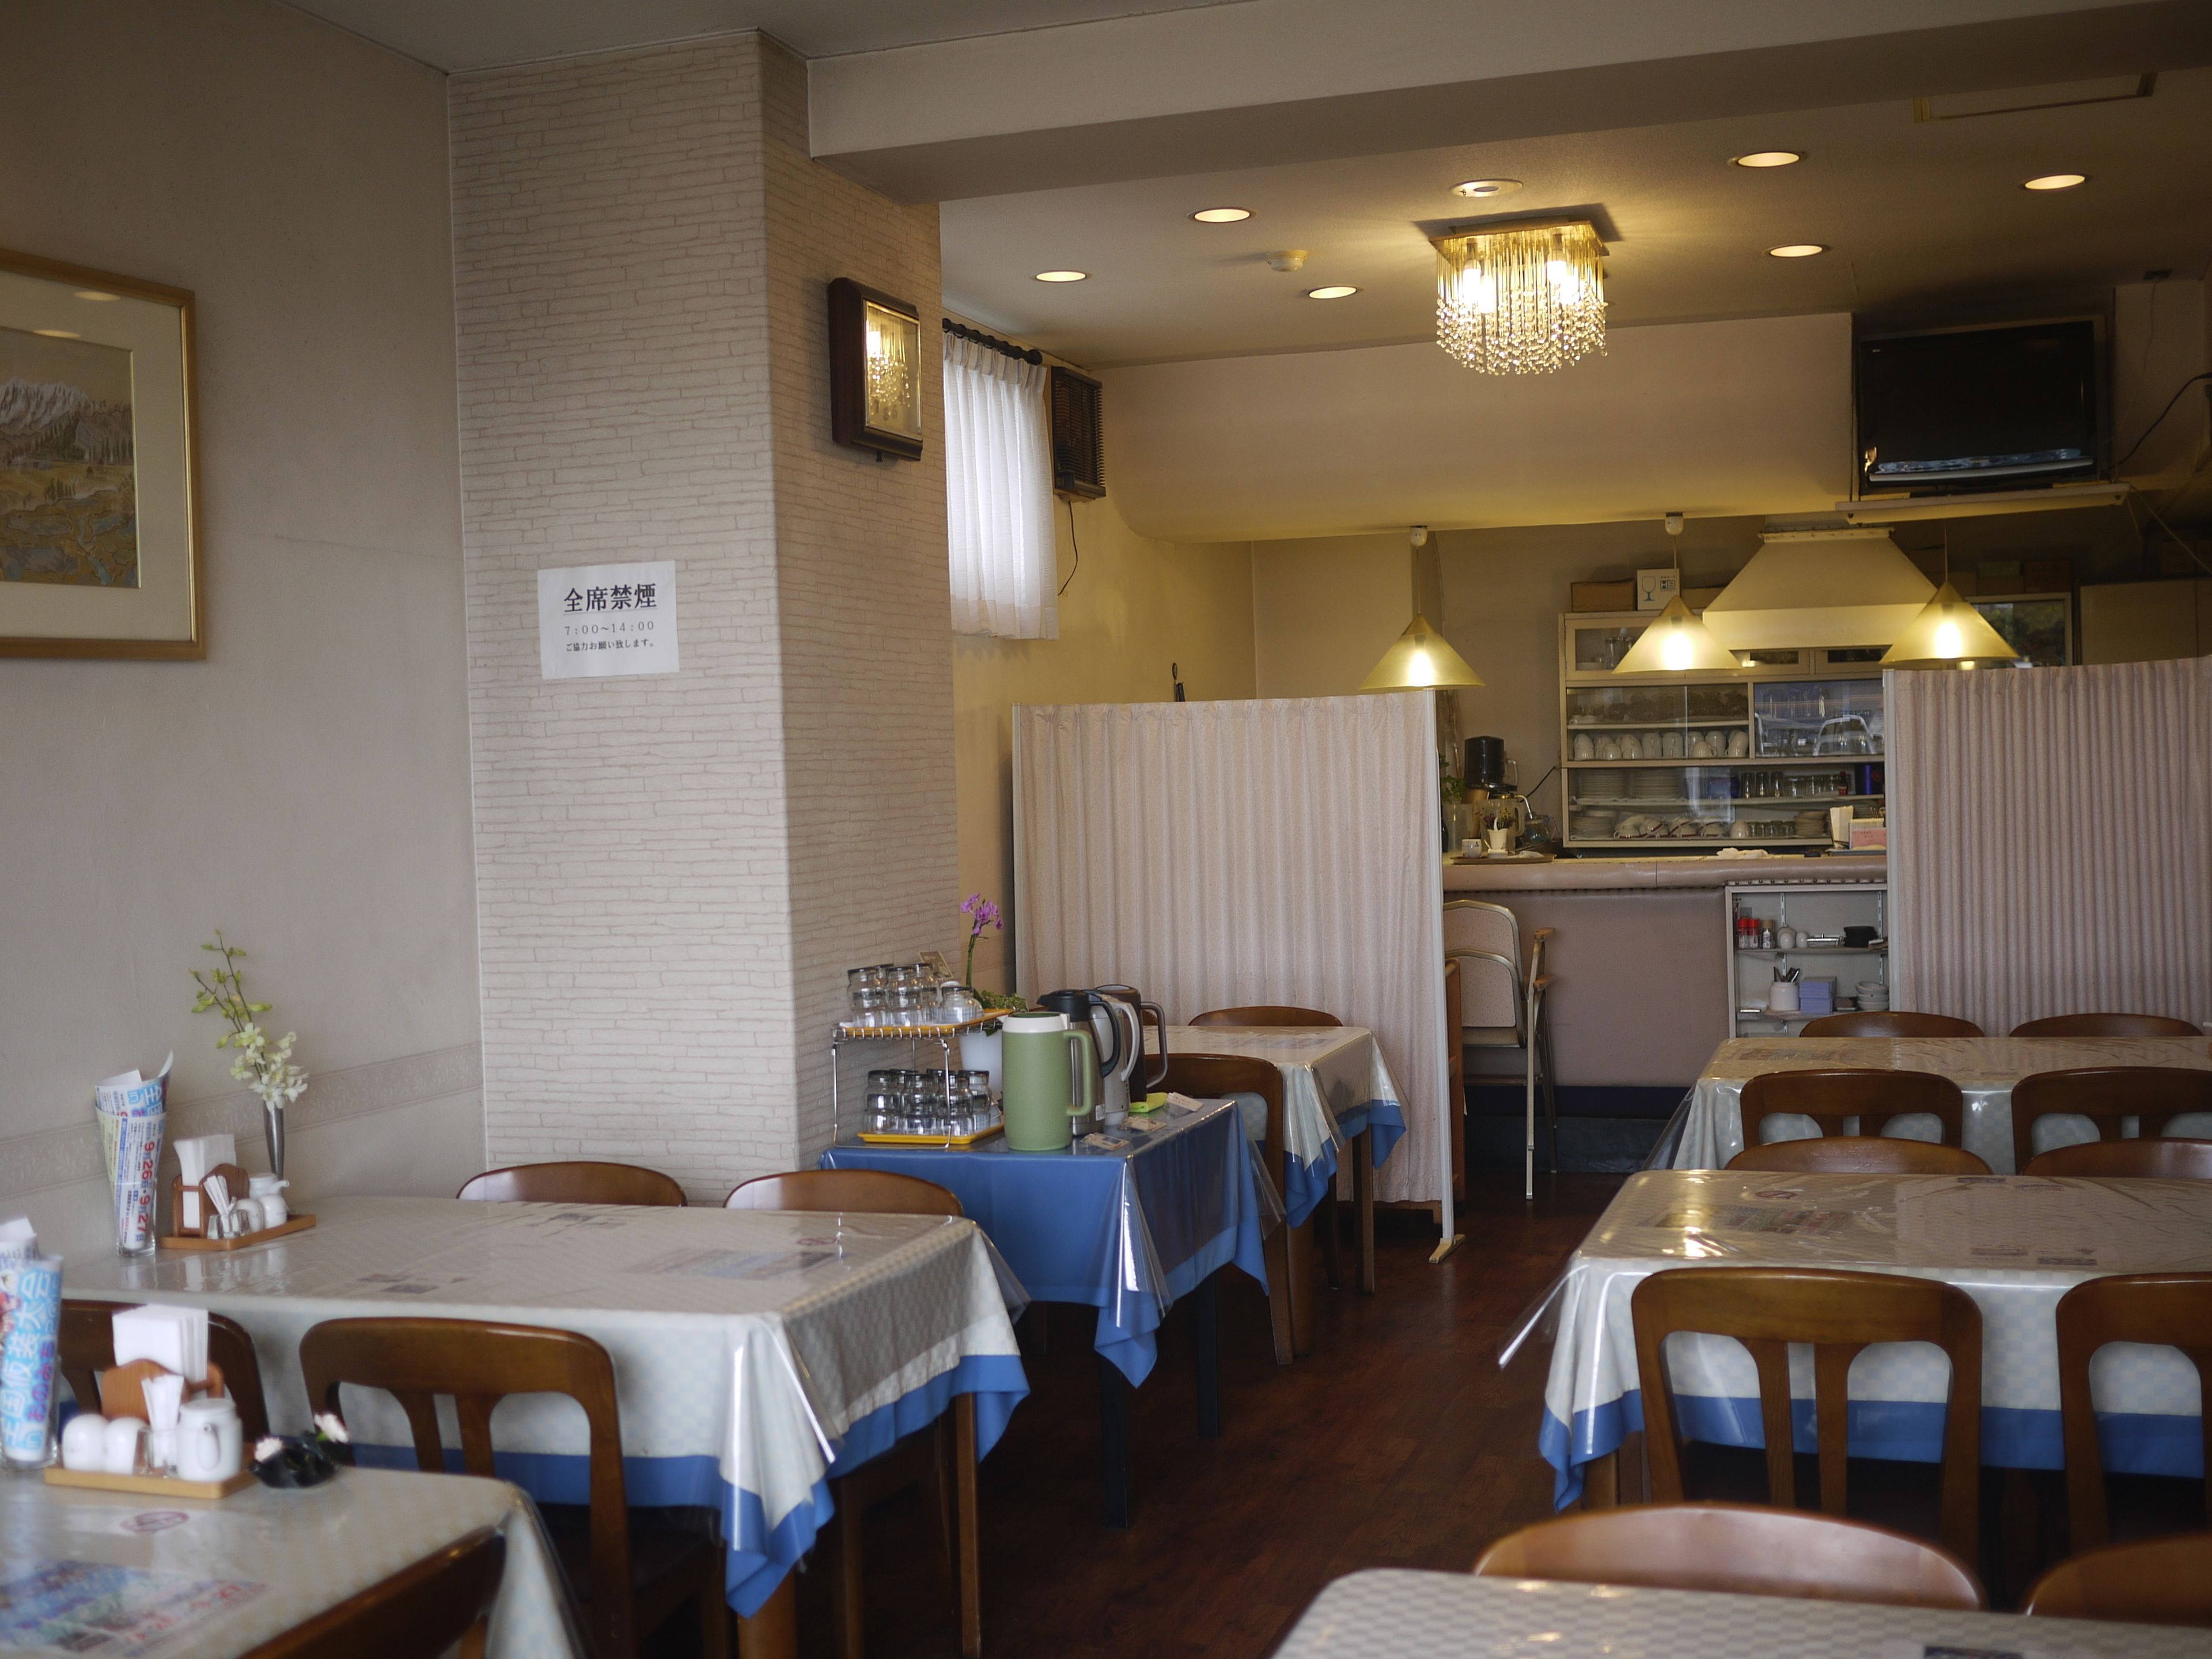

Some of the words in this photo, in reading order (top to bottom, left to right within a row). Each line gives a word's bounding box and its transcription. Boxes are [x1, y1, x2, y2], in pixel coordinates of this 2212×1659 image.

[564, 583, 657, 612] 全席禁煙
[566, 638, 654, 652] ご協力お願い致します。
